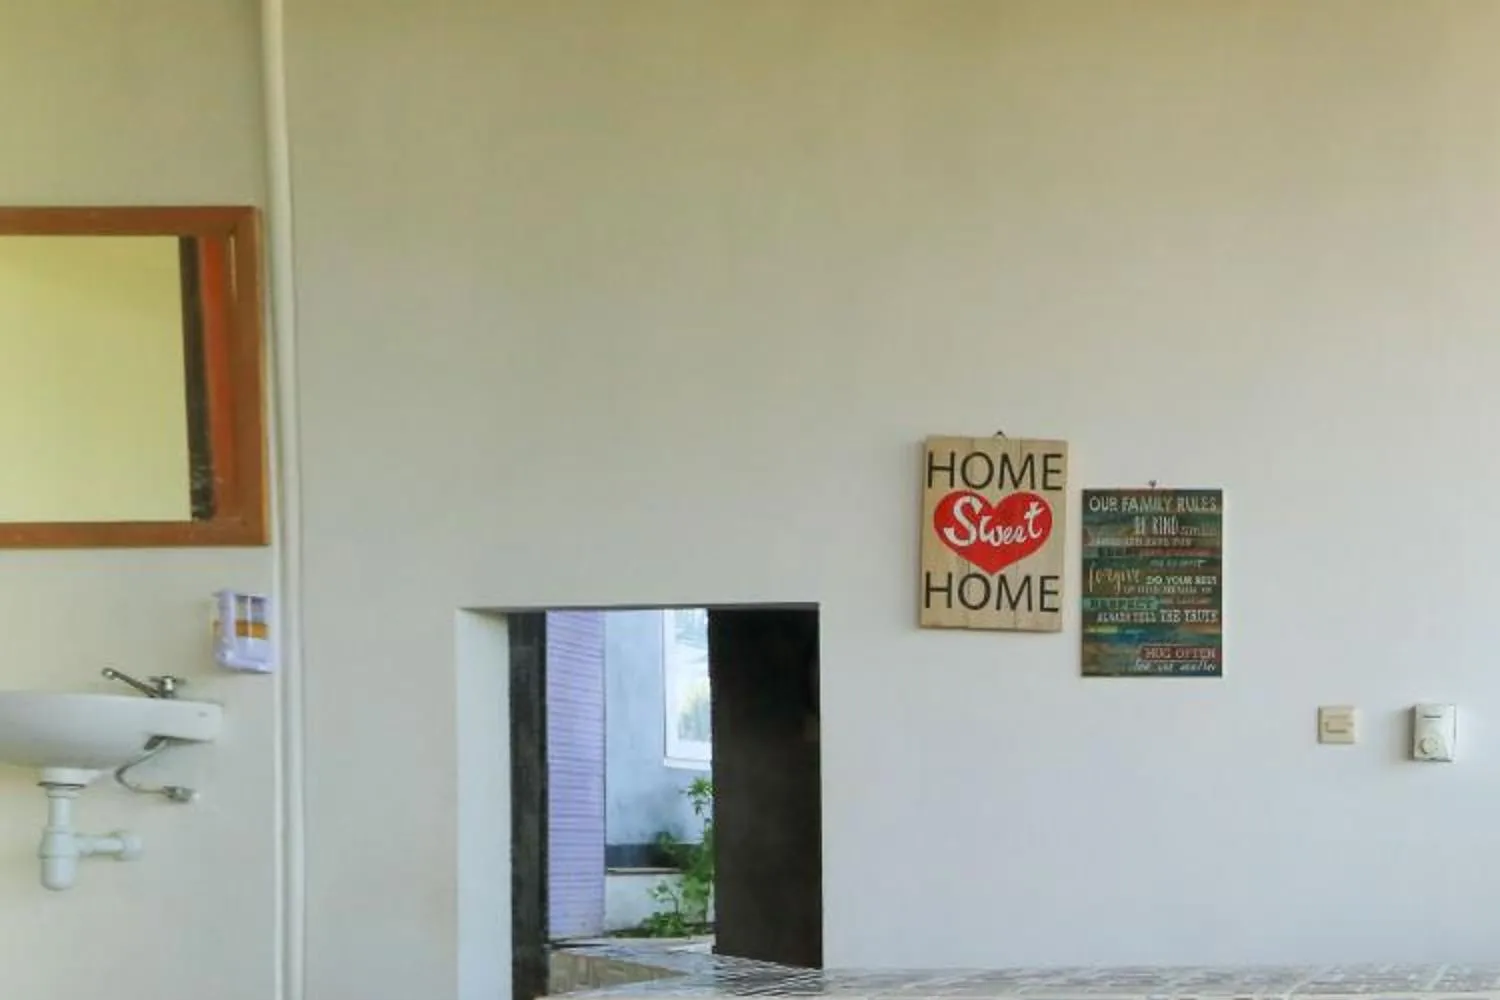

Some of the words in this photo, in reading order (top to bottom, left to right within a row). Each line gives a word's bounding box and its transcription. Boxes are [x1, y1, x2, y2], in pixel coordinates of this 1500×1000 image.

[926, 451, 1064, 491] HOME
[943, 494, 1046, 547] Sweet
[1089, 496, 1118, 513] OUR
[1121, 496, 1173, 513] FAMILY
[1177, 496, 1217, 513] RULES
[924, 572, 1061, 614] HOME
[1166, 576, 1192, 585] YOUR
